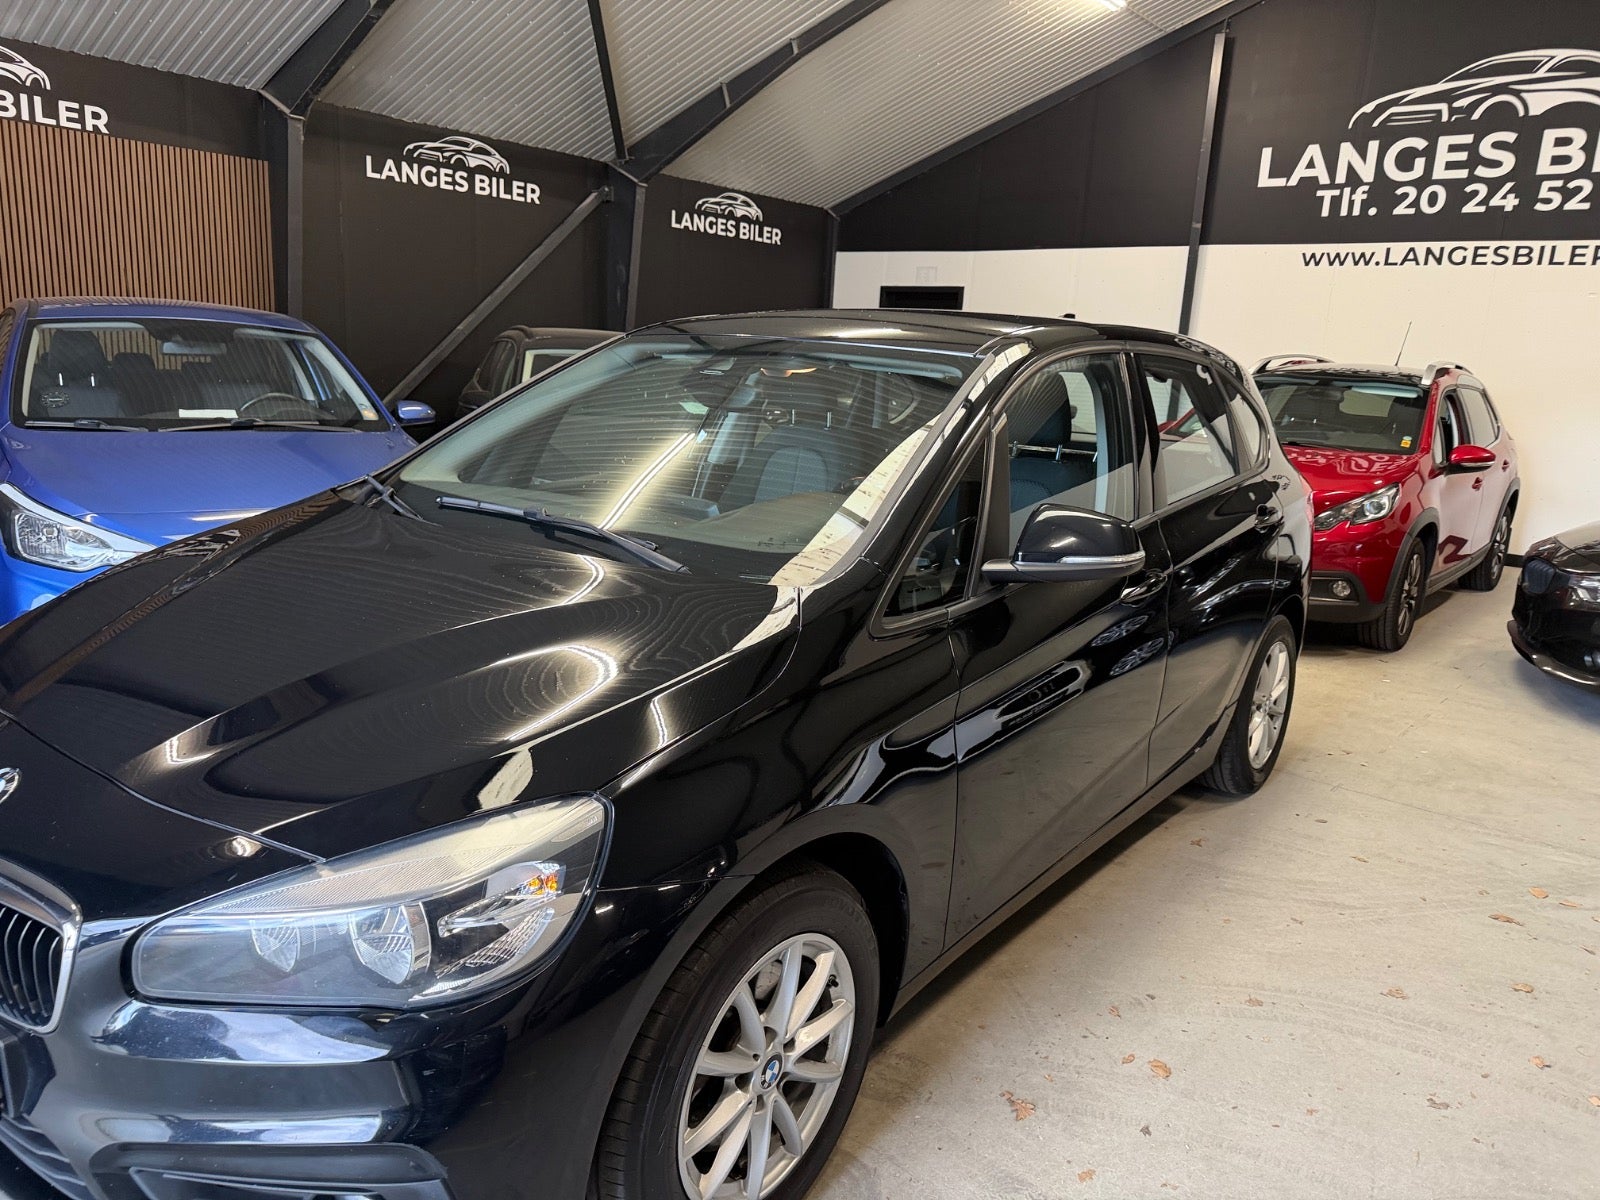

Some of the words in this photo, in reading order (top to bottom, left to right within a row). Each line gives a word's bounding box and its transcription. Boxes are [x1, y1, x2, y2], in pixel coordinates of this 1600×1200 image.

[366, 155, 469, 193] LANGES
[474, 173, 541, 205] BILER
[1257, 131, 1519, 187] LANGES
[1315, 185, 1378, 218] Tlf.
[1392, 184, 1447, 215] 20
[1461, 182, 1520, 213] 24
[1533, 178, 1594, 211] 52
[671, 209, 737, 238] LANGES
[739, 221, 782, 246] BILER
